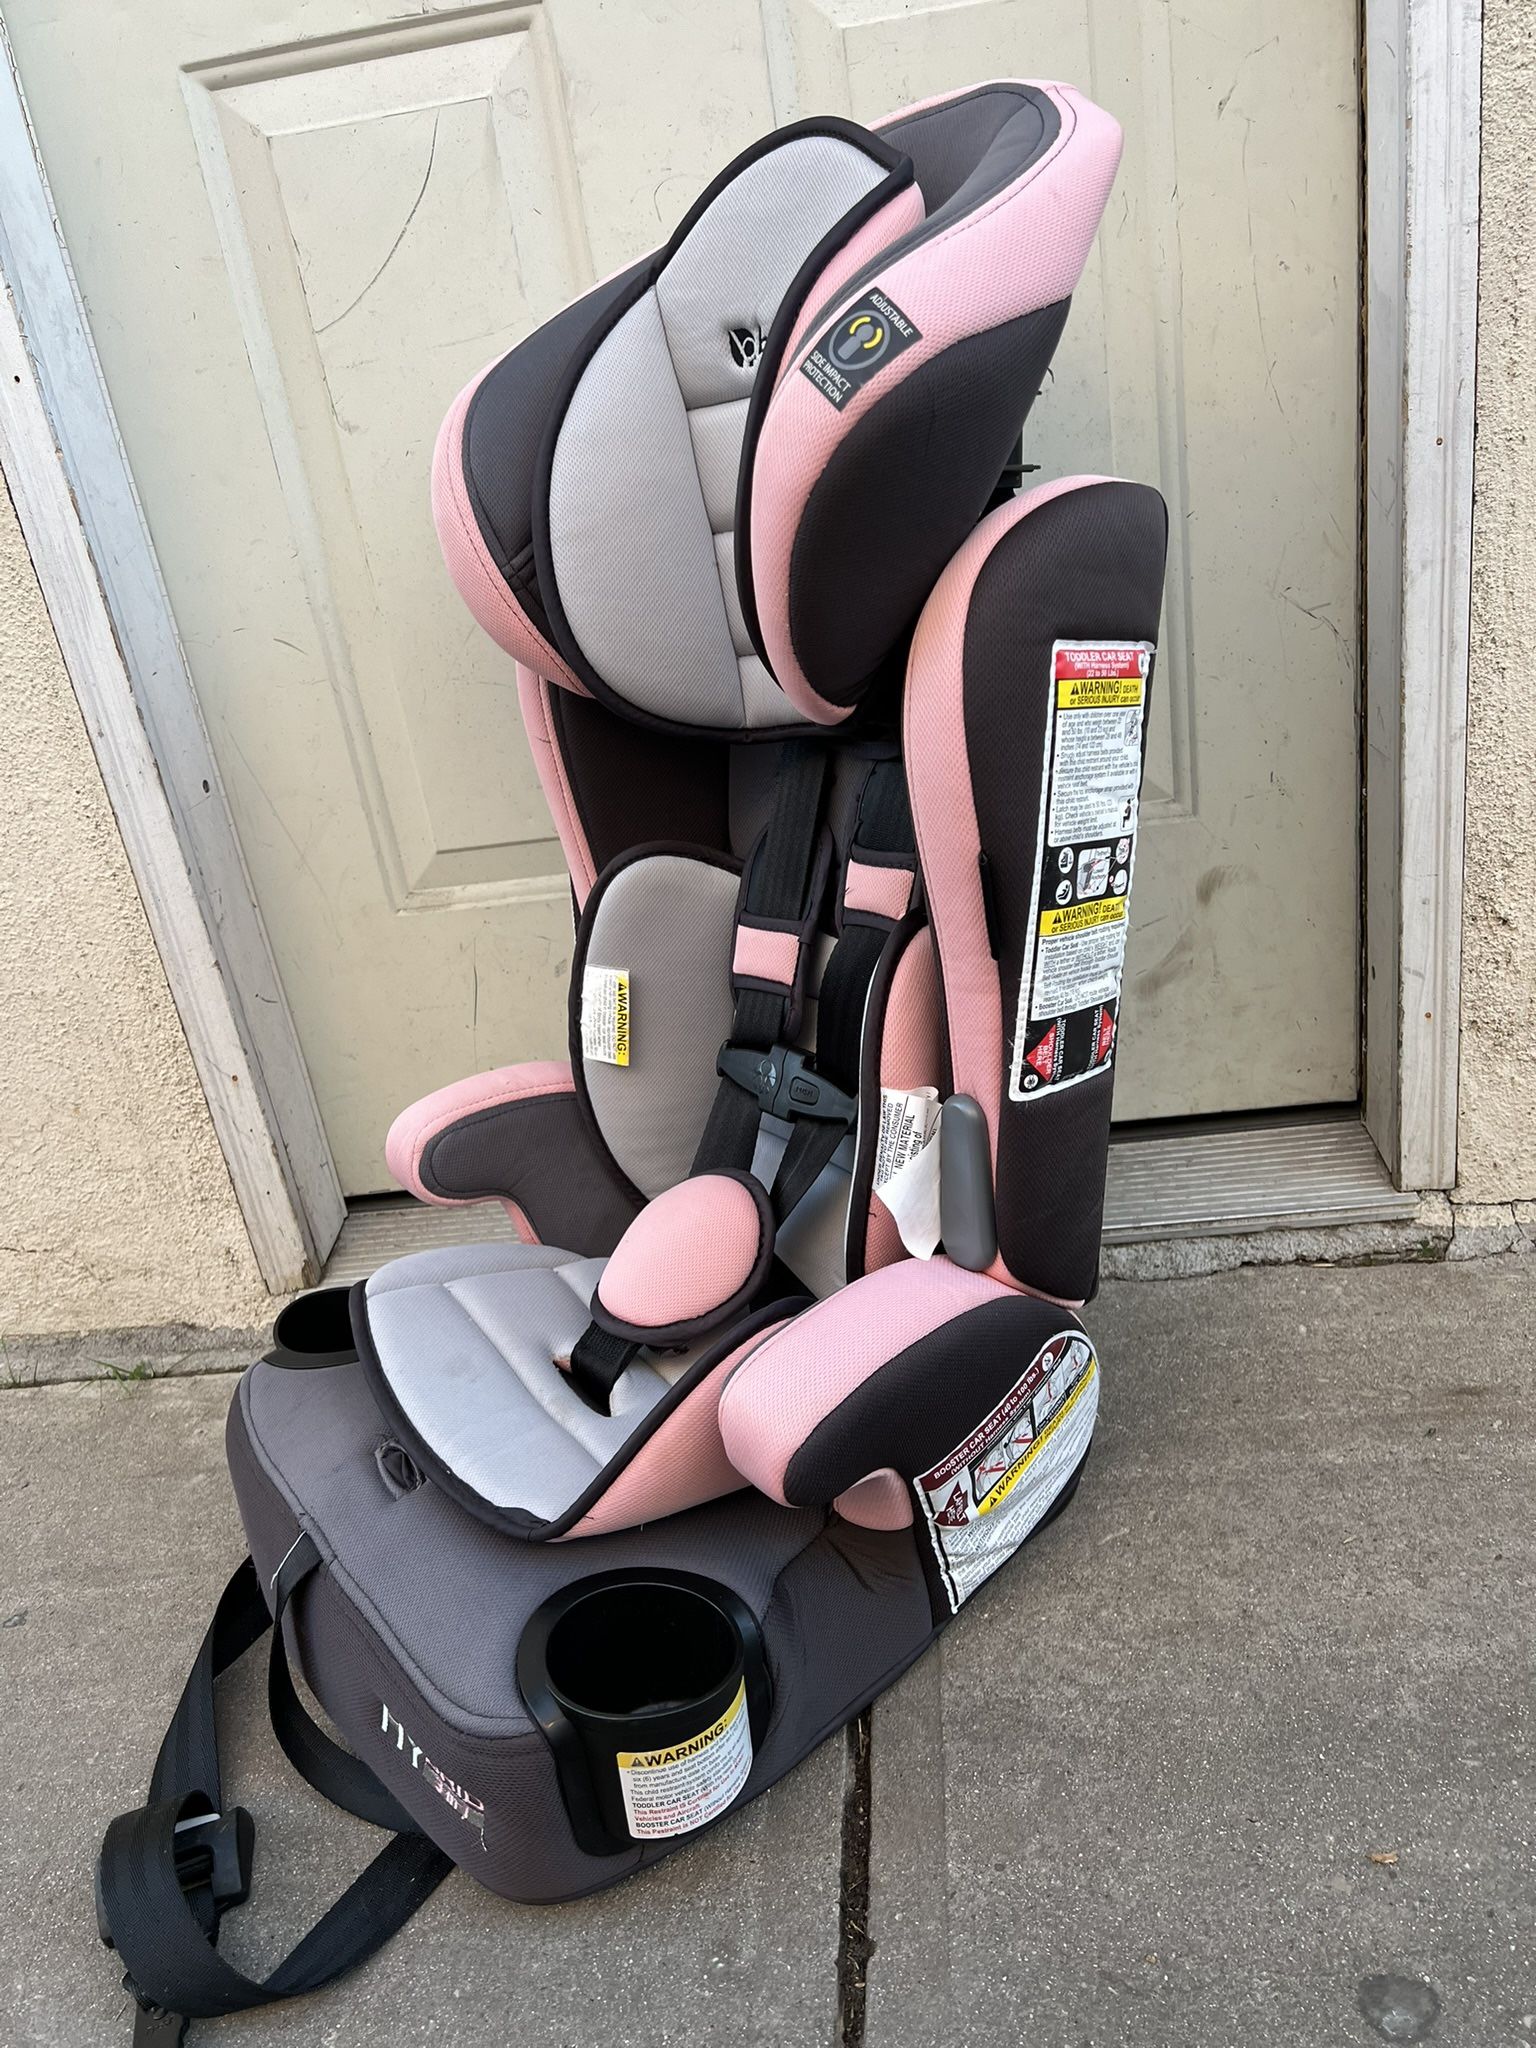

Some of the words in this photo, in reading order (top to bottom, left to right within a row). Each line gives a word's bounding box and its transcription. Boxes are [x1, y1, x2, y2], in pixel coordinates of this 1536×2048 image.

[869, 294, 913, 338] ADJUSTABLE
[802, 360, 843, 403] PROTECTION
[810, 350, 825, 368] SIDE
[823, 362, 851, 392] IMPACT
[1065, 652, 1100, 662] TODDLER
[1101, 652, 1118, 662] CAR
[1117, 652, 1134, 662] SEAT
[1080, 681, 1122, 695] WARNING!
[1123, 685, 1138, 693] DEATH
[1077, 696, 1100, 705] SERIOUS
[1101, 695, 1120, 704] INJURY
[1060, 919, 1083, 932] SERIOUS
[1084, 915, 1100, 926] INJURY
[1100, 914, 1109, 922] can
[1110, 911, 1124, 920] occur
[1062, 902, 1102, 923] WARNING!
[616, 992, 628, 1056] WARNING:
[1045, 1032, 1055, 1075] SHOULDER
[795, 1085, 814, 1098] PUSH
[886, 1103, 894, 1134] REMOVED
[889, 1102, 903, 1140] CONSUMER
[898, 1114, 915, 1152] MATERIAL
[914, 1130, 922, 1139] of
[887, 1141, 895, 1152] THE
[886, 1154, 892, 1163] BY
[894, 1152, 906, 1169] NEW
[883, 1163, 891, 1184] XCEPT
[934, 1448, 970, 1479] BOOSTER
[969, 1432, 986, 1450] CAR
[984, 1414, 1002, 1434] SEAT
[1009, 1396, 1018, 1405] to
[1017, 1383, 1028, 1396] 100
[1026, 1367, 1040, 1384] lbs.)
[951, 1443, 985, 1475] (WITHOUT
[995, 1435, 1044, 1496] WARNING!
[644, 1718, 728, 1767] WARNING:
[630, 1767, 667, 1776] Discontinue
[649, 1775, 687, 1788] manufacture
[701, 1764, 708, 1772] on
[652, 1773, 670, 1781] years
[684, 1764, 697, 1772] seat
[655, 1793, 673, 1801] motor
[696, 1776, 712, 1787] safety
[660, 1781, 685, 1793] restraint
[687, 1772, 706, 1785] system
[683, 1790, 699, 1802] SEAT
[649, 1805, 679, 1814] Restraint
[680, 1800, 686, 1808] IS
[686, 1809, 703, 1821] SEAT
[689, 1817, 703, 1825] NOT
[704, 1800, 727, 1818] Certified
